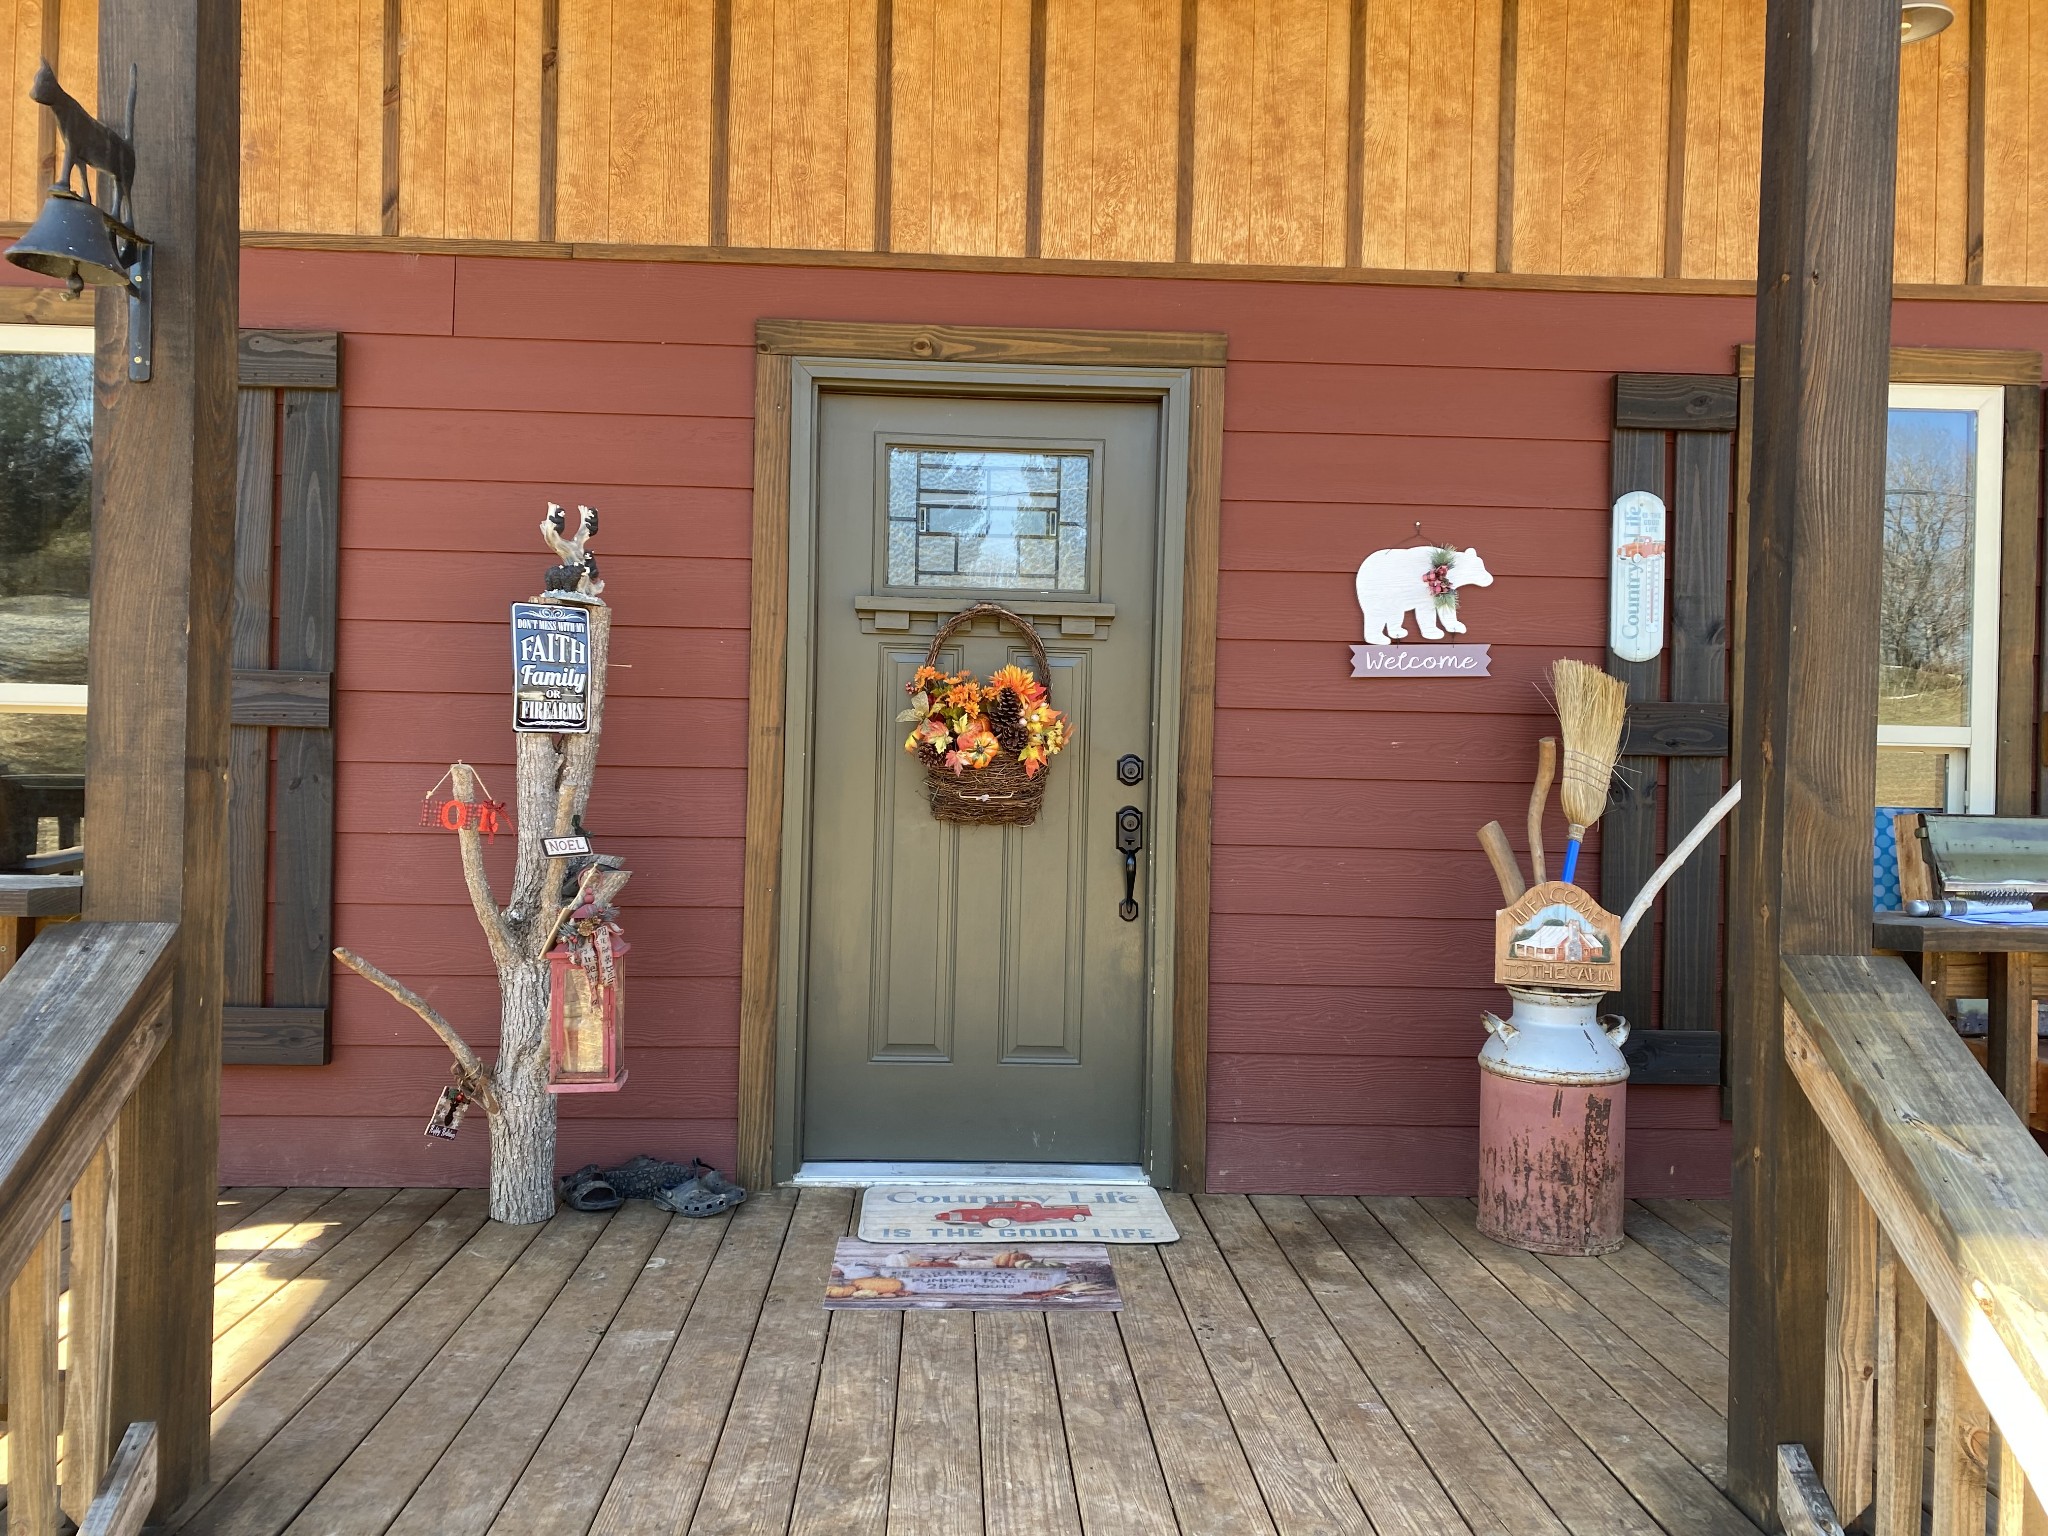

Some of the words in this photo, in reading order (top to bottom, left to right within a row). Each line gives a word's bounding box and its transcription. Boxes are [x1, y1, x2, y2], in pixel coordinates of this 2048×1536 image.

[1624, 506, 1641, 538] Life
[1621, 562, 1643, 639] Country
[517, 619, 537, 630] DON'T
[540, 620, 557, 631] MESS
[558, 621, 575, 633] WITH
[575, 622, 585, 633] MY
[521, 633, 585, 664] FAITH
[1366, 651, 1478, 670] Welcome
[521, 665, 585, 693] Family
[545, 689, 561, 699] OR
[521, 700, 585, 720] FIREARMS
[548, 839, 586, 852] NOEL
[1509, 887, 1607, 928] WELCOME
[1504, 963, 1528, 979] TO
[1532, 964, 1566, 980] THE
[1567, 965, 1614, 982] CABIN
[887, 1191, 1052, 1204] Country
[1069, 1189, 1140, 1205] Life
[882, 1228, 911, 1239] IS
[926, 1228, 983, 1239] THE
[998, 1228, 1078, 1239] GOOD
[1092, 1228, 1156, 1240] LIFE
